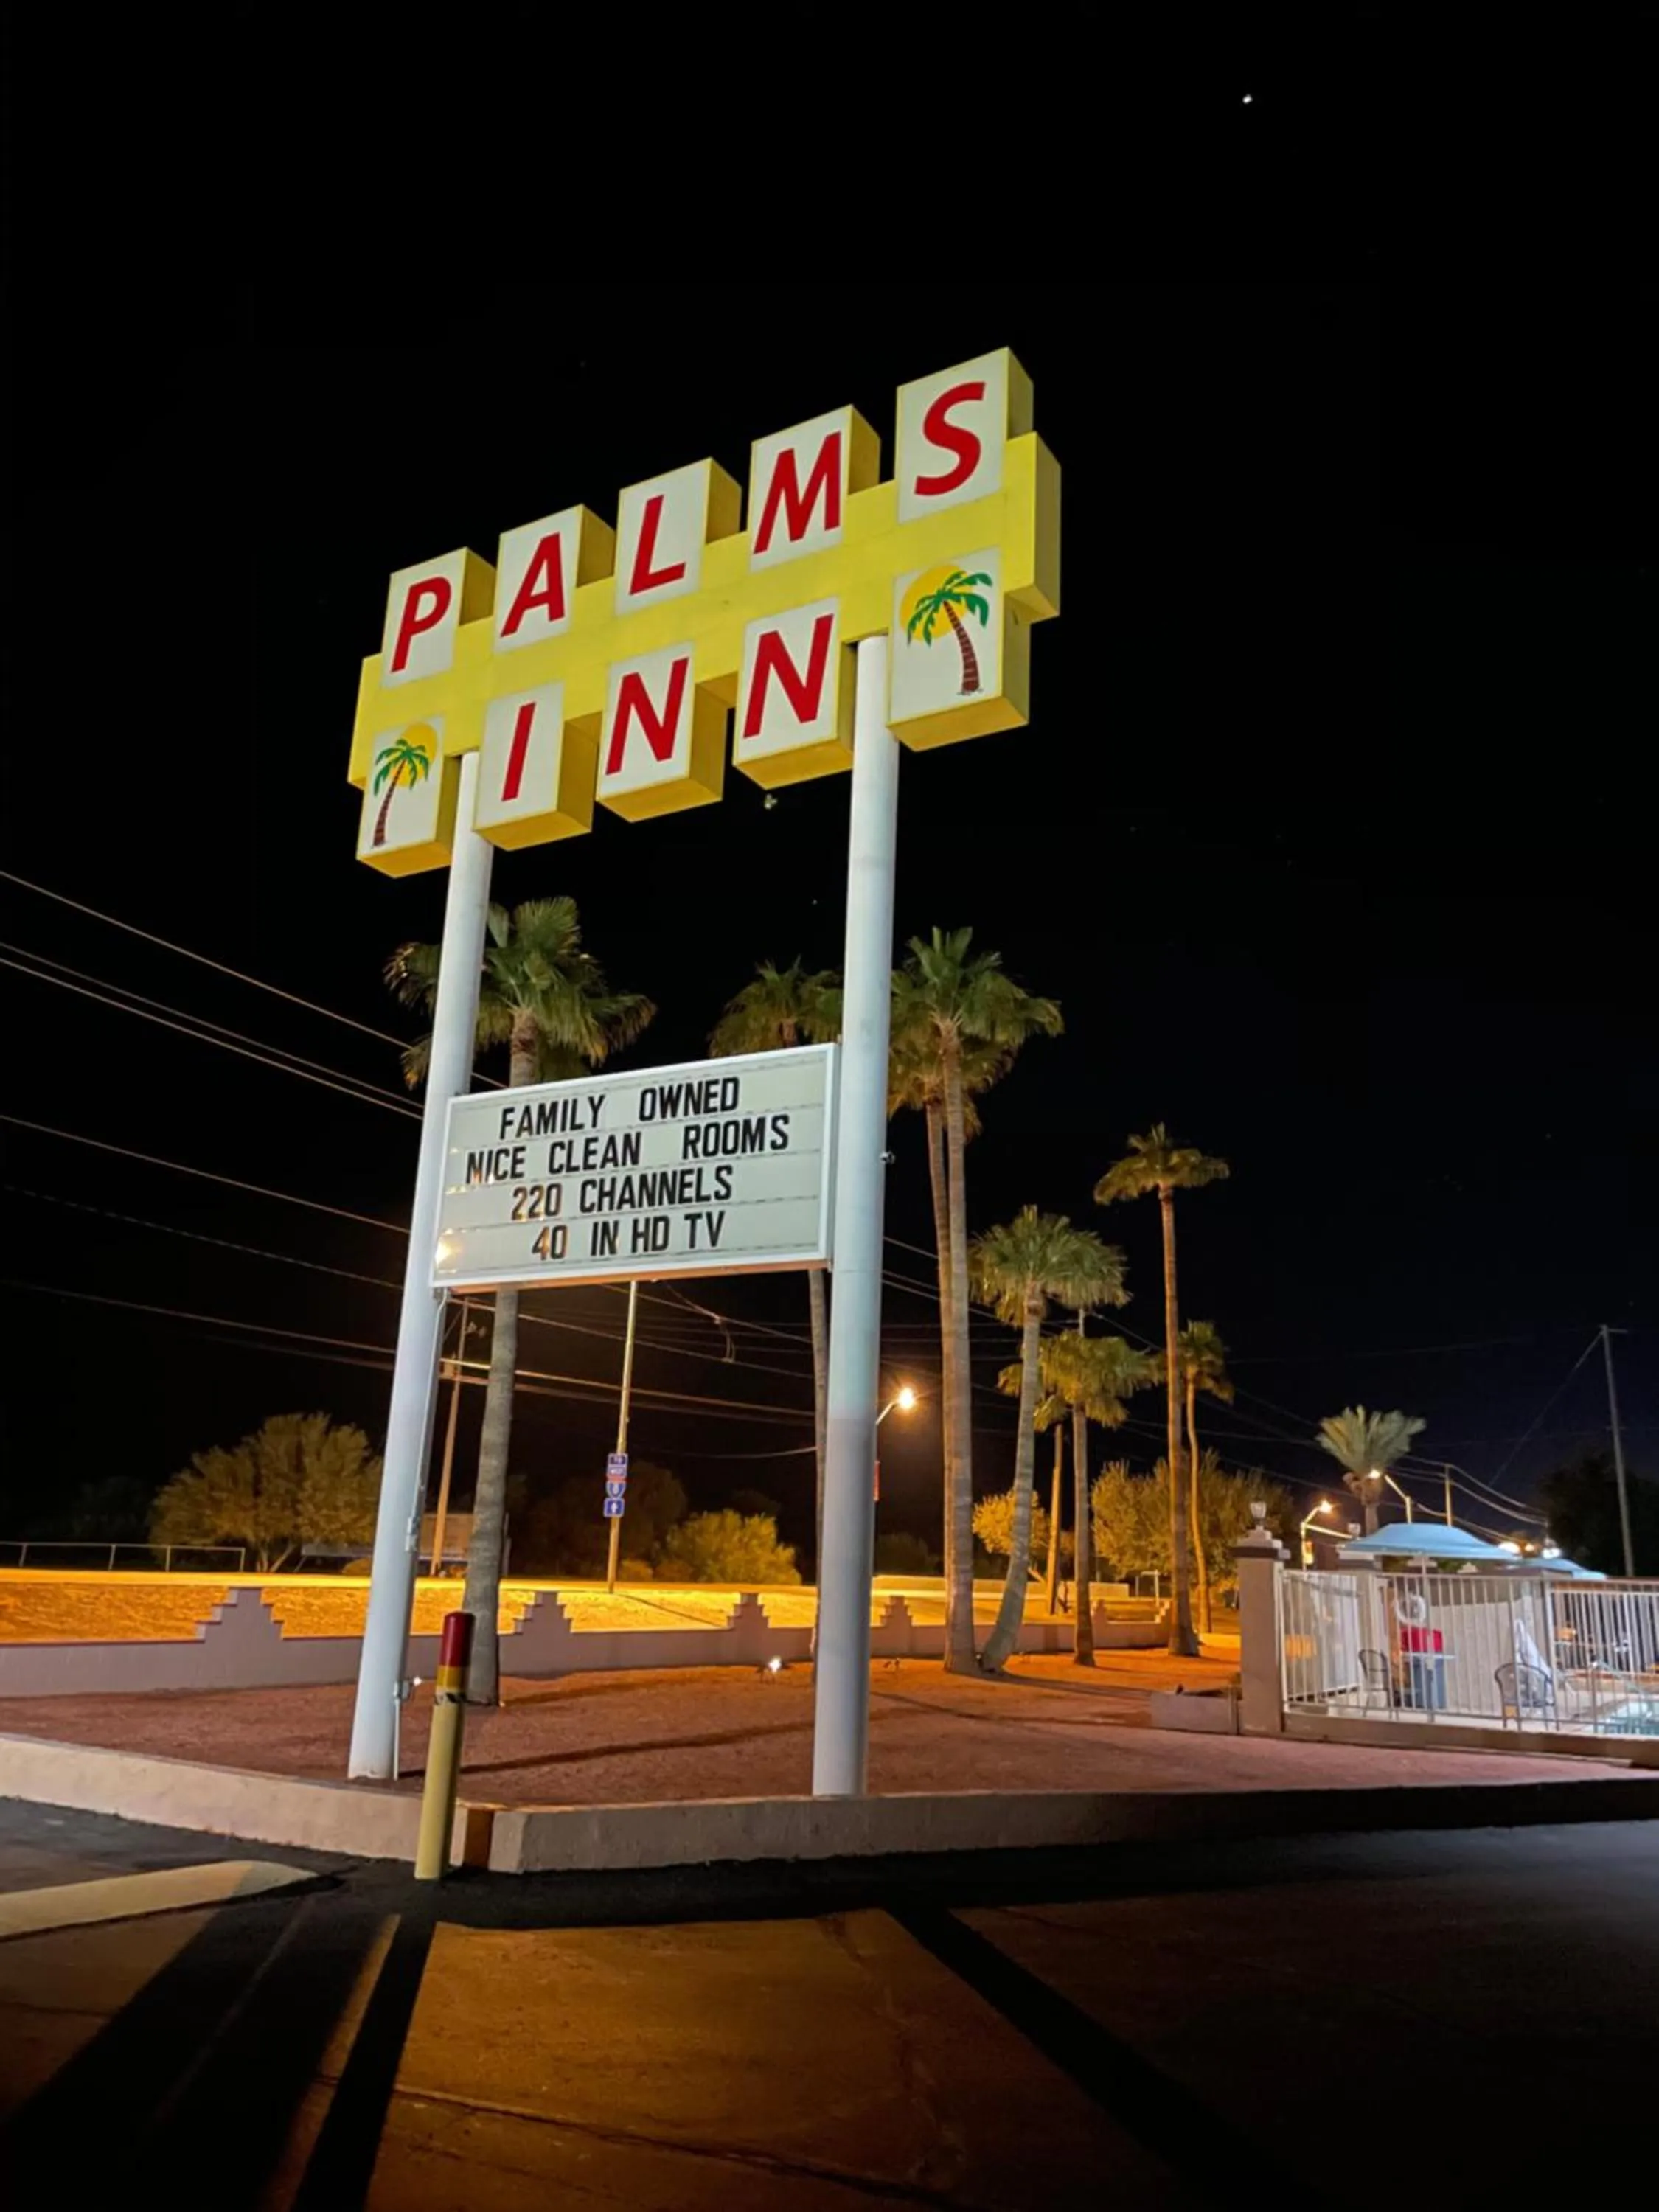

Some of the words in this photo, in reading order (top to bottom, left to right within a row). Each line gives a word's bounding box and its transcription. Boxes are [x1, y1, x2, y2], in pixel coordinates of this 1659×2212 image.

[392, 383, 984, 672] PALMS
[503, 615, 832, 801] INN
[499, 1094, 605, 1140] FAMILY
[639, 1077, 740, 1122] OWNED
[465, 1145, 526, 1184] NICE
[548, 1131, 641, 1175] CLEAN
[682, 1114, 790, 1160] ROOMS
[512, 1183, 562, 1221] 220
[580, 1164, 733, 1214] CHANNELS
[532, 1225, 567, 1260] 40
[591, 1220, 619, 1256] IN
[631, 1215, 670, 1253] HD
[684, 1210, 726, 1249] TV
